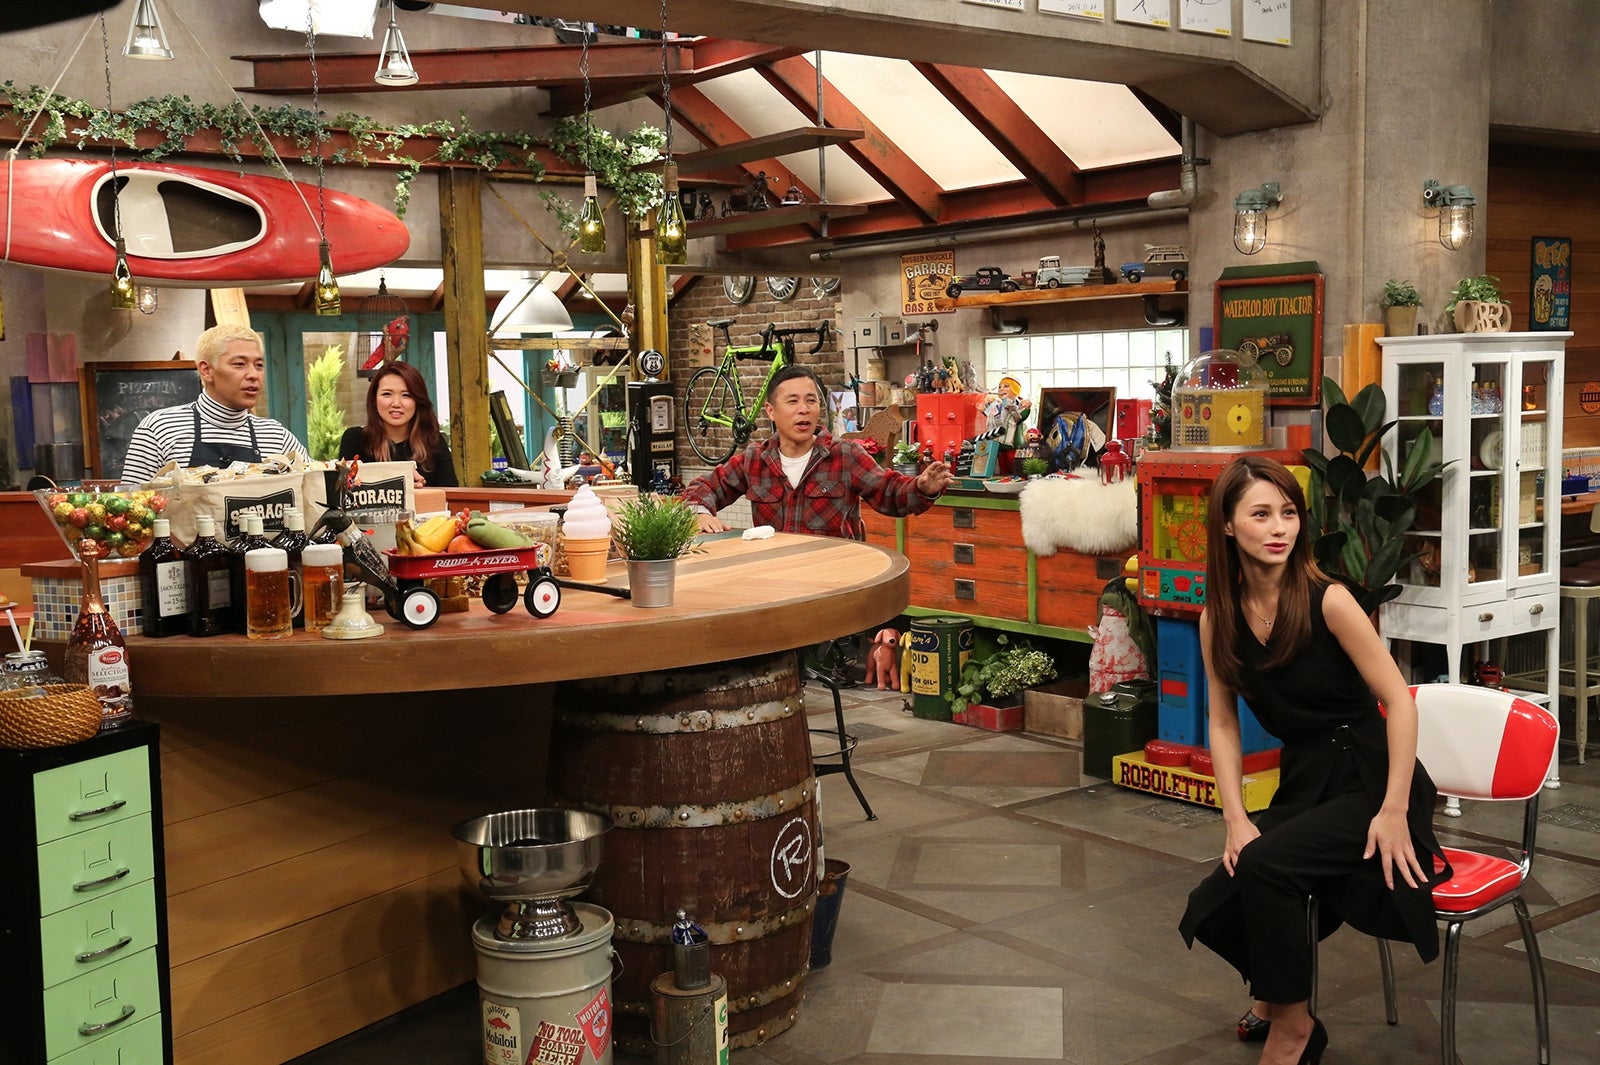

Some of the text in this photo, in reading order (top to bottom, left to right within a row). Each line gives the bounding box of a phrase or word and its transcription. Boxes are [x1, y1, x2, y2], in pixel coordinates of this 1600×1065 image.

[925, 252, 953, 262] KNUCKLE
[1535, 241, 1570, 268] BEER
[905, 262, 953, 279] GARAGE
[1553, 281, 1569, 294] LIFE
[905, 303, 924, 313] GAS
[927, 301, 934, 311] &
[1223, 295, 1312, 318] WATERLOO BOY TRACTOR
[433, 555, 519, 568] RADIO FLYER
[1120, 761, 1215, 806] ROBOLETTE
[580, 1001, 601, 1026] MOTOR
[538, 1023, 556, 1039] NO
[556, 1027, 587, 1044] TOOLS
[539, 1039, 580, 1055] LOANED
[536, 1050, 577, 1065] HERE
